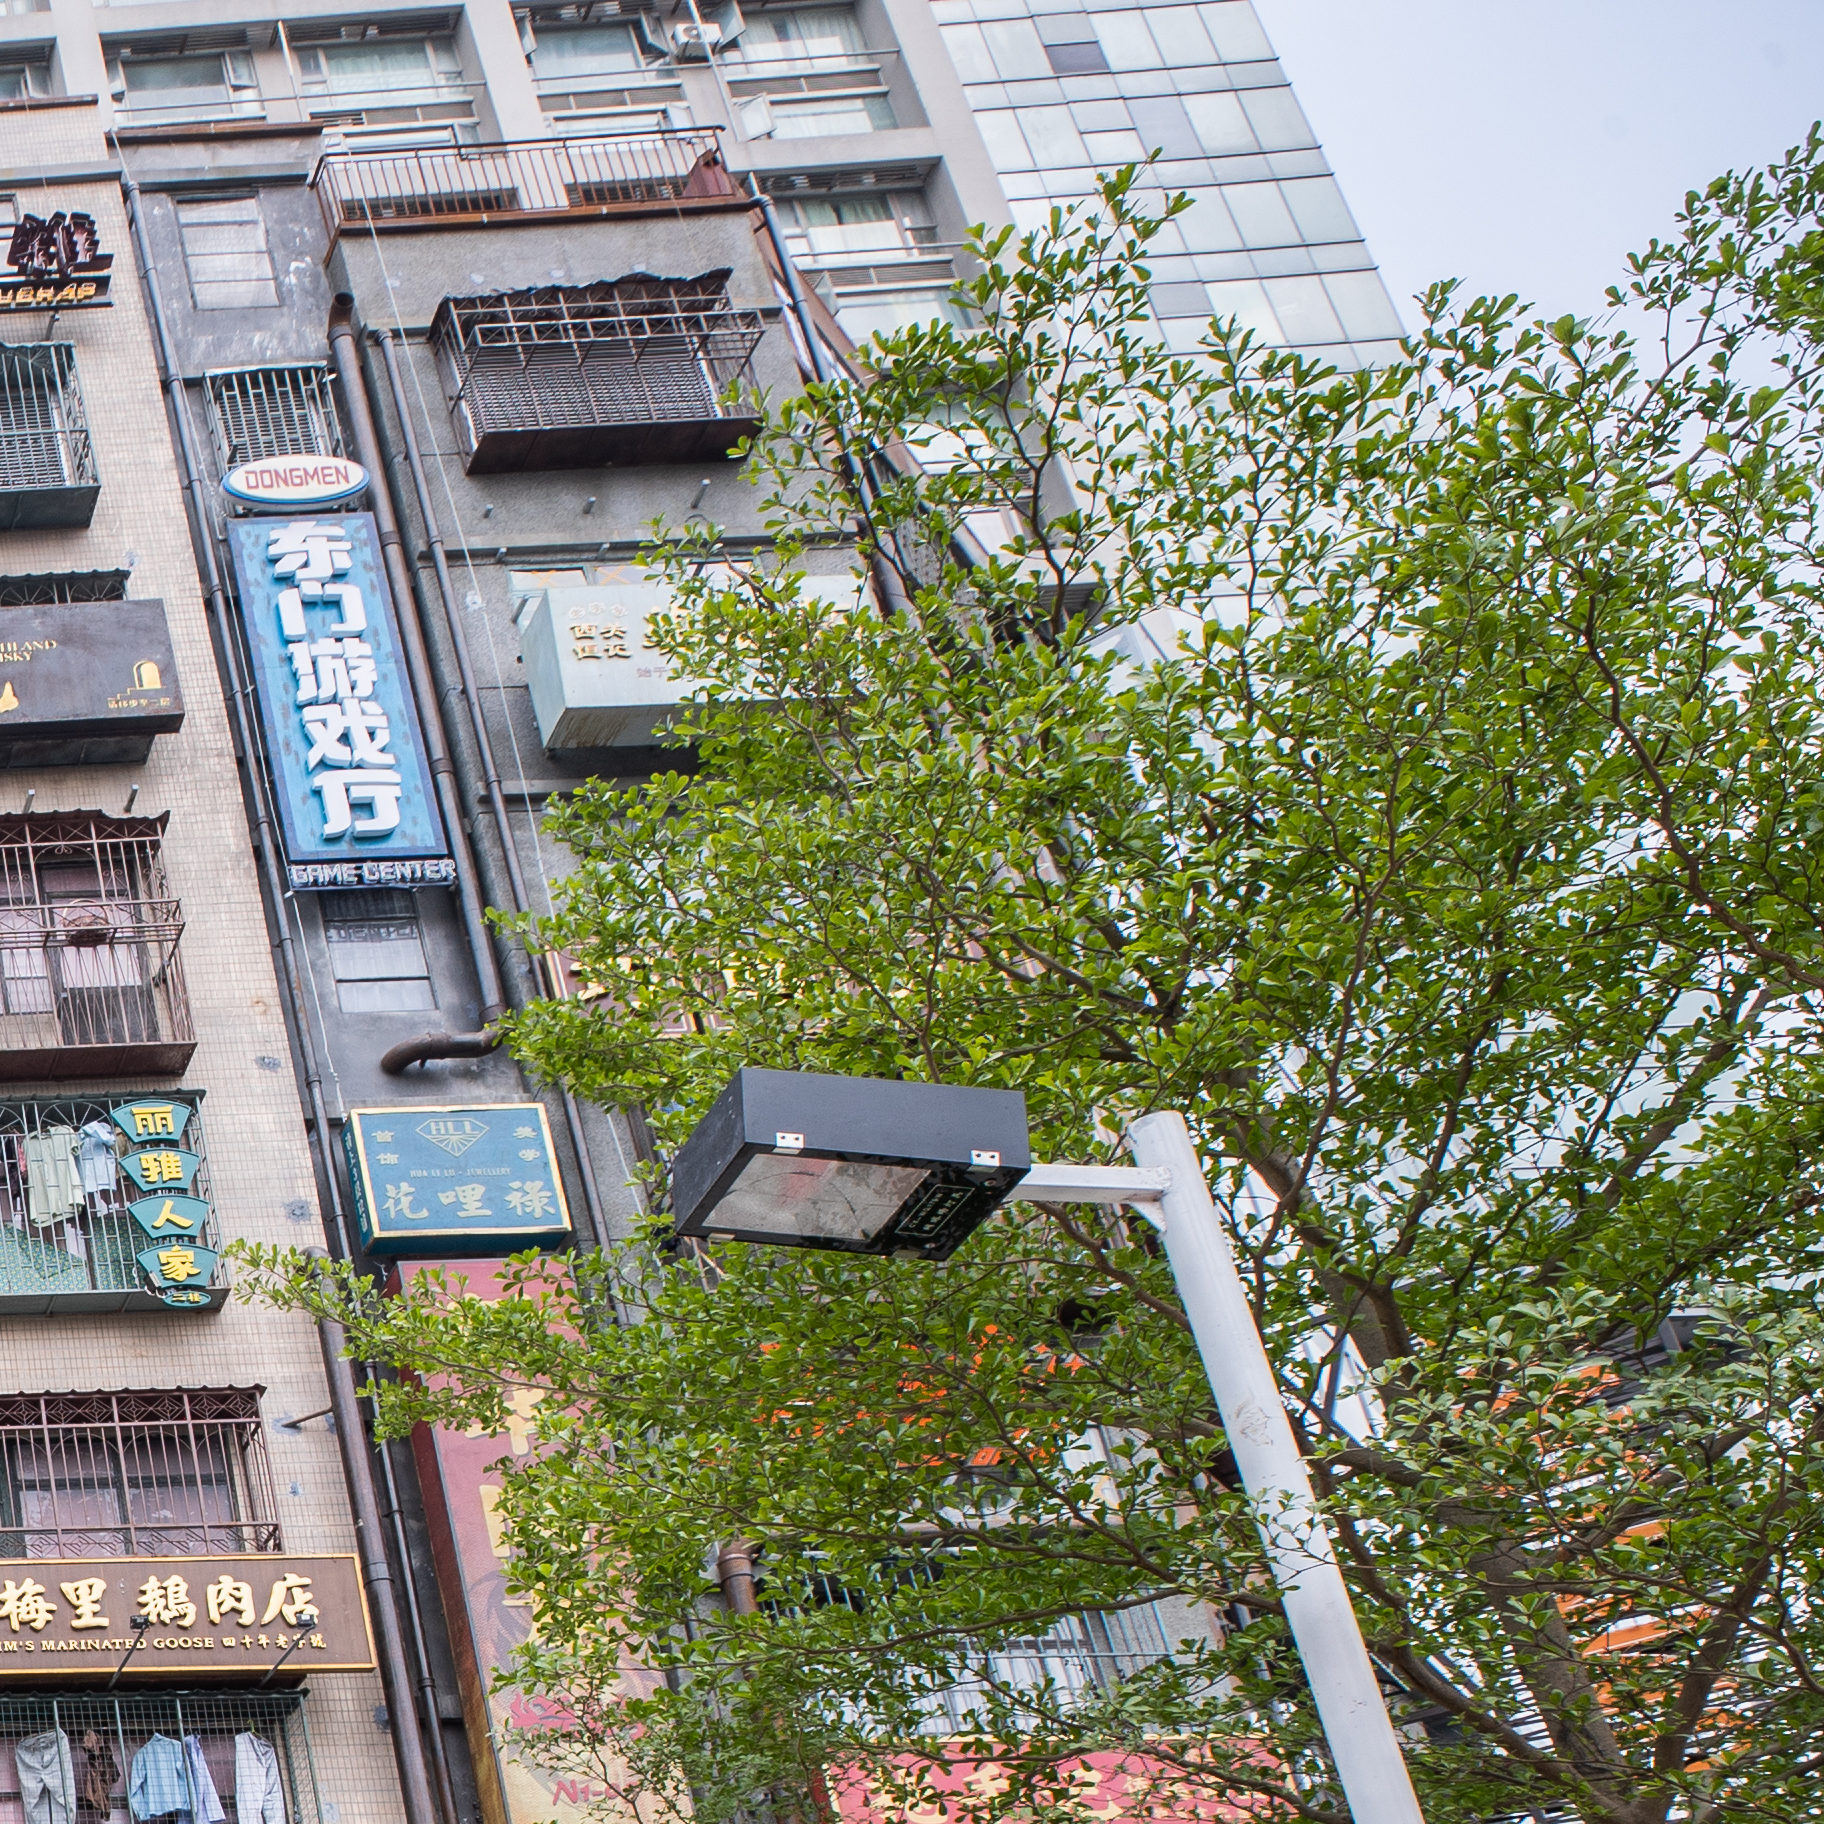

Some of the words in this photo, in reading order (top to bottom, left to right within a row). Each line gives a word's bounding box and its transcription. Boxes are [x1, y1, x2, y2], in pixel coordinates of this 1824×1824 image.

[244, 463, 351, 489] DONGMEN
[269, 519, 400, 839] 东门游戏厅
[290, 863, 358, 887] GAME
[361, 859, 457, 886] CENTER
[430, 1120, 480, 1136] HLL
[370, 1129, 400, 1166] 首饰
[410, 1169, 428, 1179] HUA
[466, 1167, 512, 1177] JEWELLERY
[131, 1104, 202, 1283] 丽雅人家
[42, 1637, 147, 1652] MARINATED
[153, 1636, 214, 1650] GOOSE
